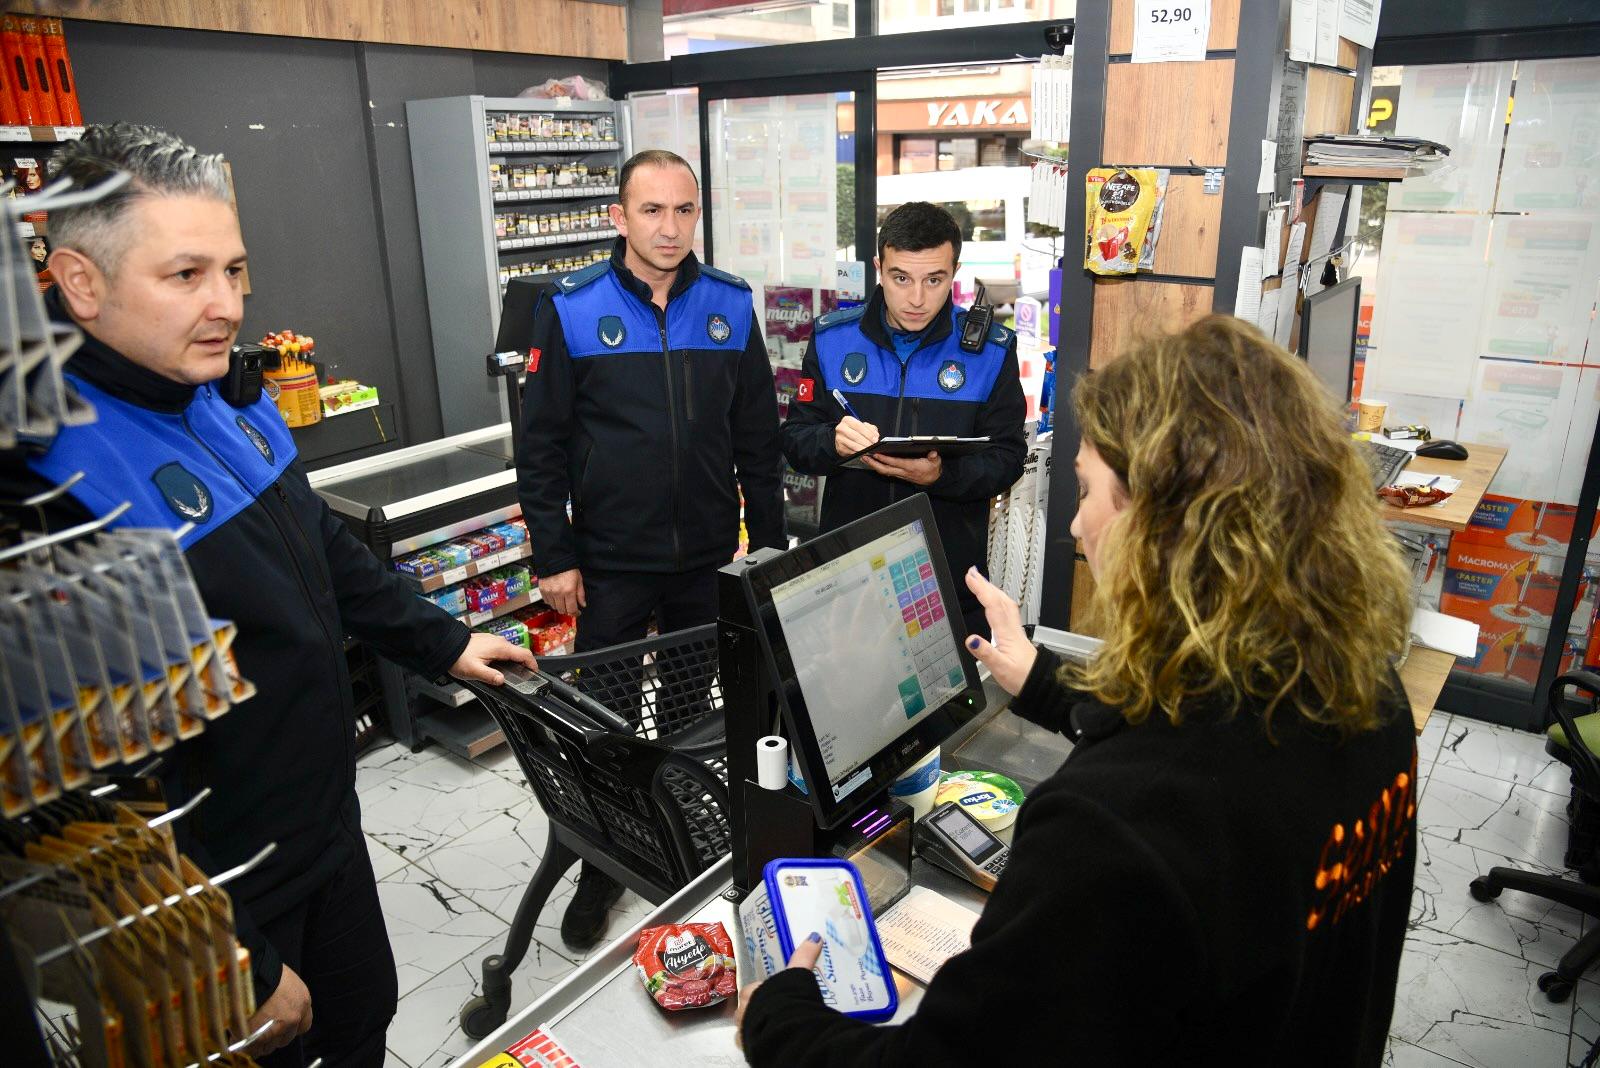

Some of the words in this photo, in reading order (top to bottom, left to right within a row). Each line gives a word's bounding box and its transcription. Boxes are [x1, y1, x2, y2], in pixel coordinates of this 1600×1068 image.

[1151, 8, 1192, 25] 52,90
[926, 100, 1029, 126] YAKA
[766, 304, 811, 332] maylo
[1479, 504, 1509, 513] ASTER
[1457, 554, 1514, 572] MACROMAX
[506, 581, 524, 593] FALIM
[480, 591, 499, 604] FALIM
[963, 792, 995, 805] Torku
